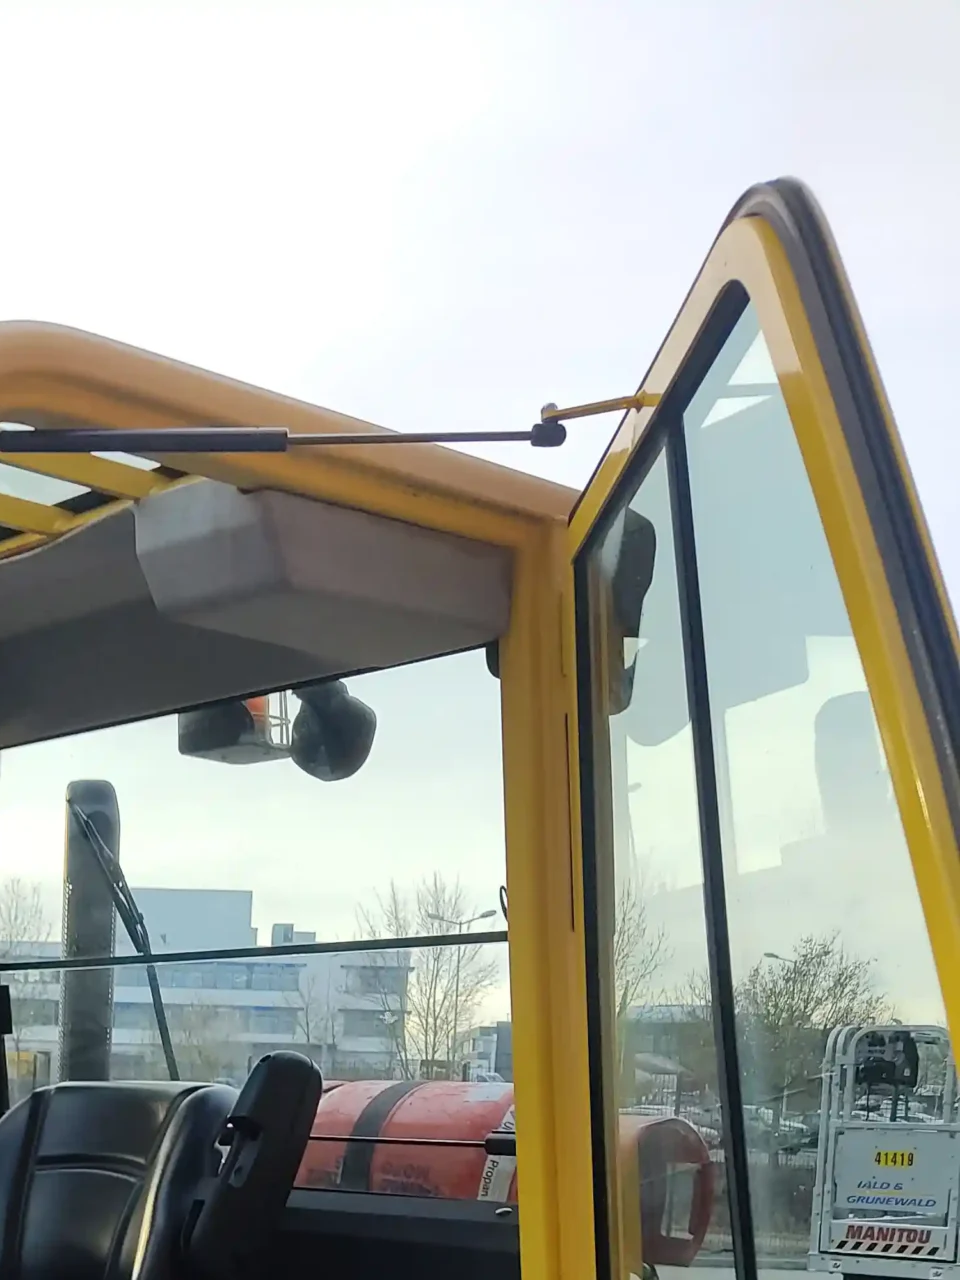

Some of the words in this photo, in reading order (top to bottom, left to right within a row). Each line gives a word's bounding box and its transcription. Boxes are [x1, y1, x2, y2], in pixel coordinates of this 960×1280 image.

[874, 1151, 914, 1167] 41419
[481, 1159, 499, 1197] Propan
[846, 1195, 936, 1207] GRUNEWALD
[845, 1225, 932, 1243] MANITOU
